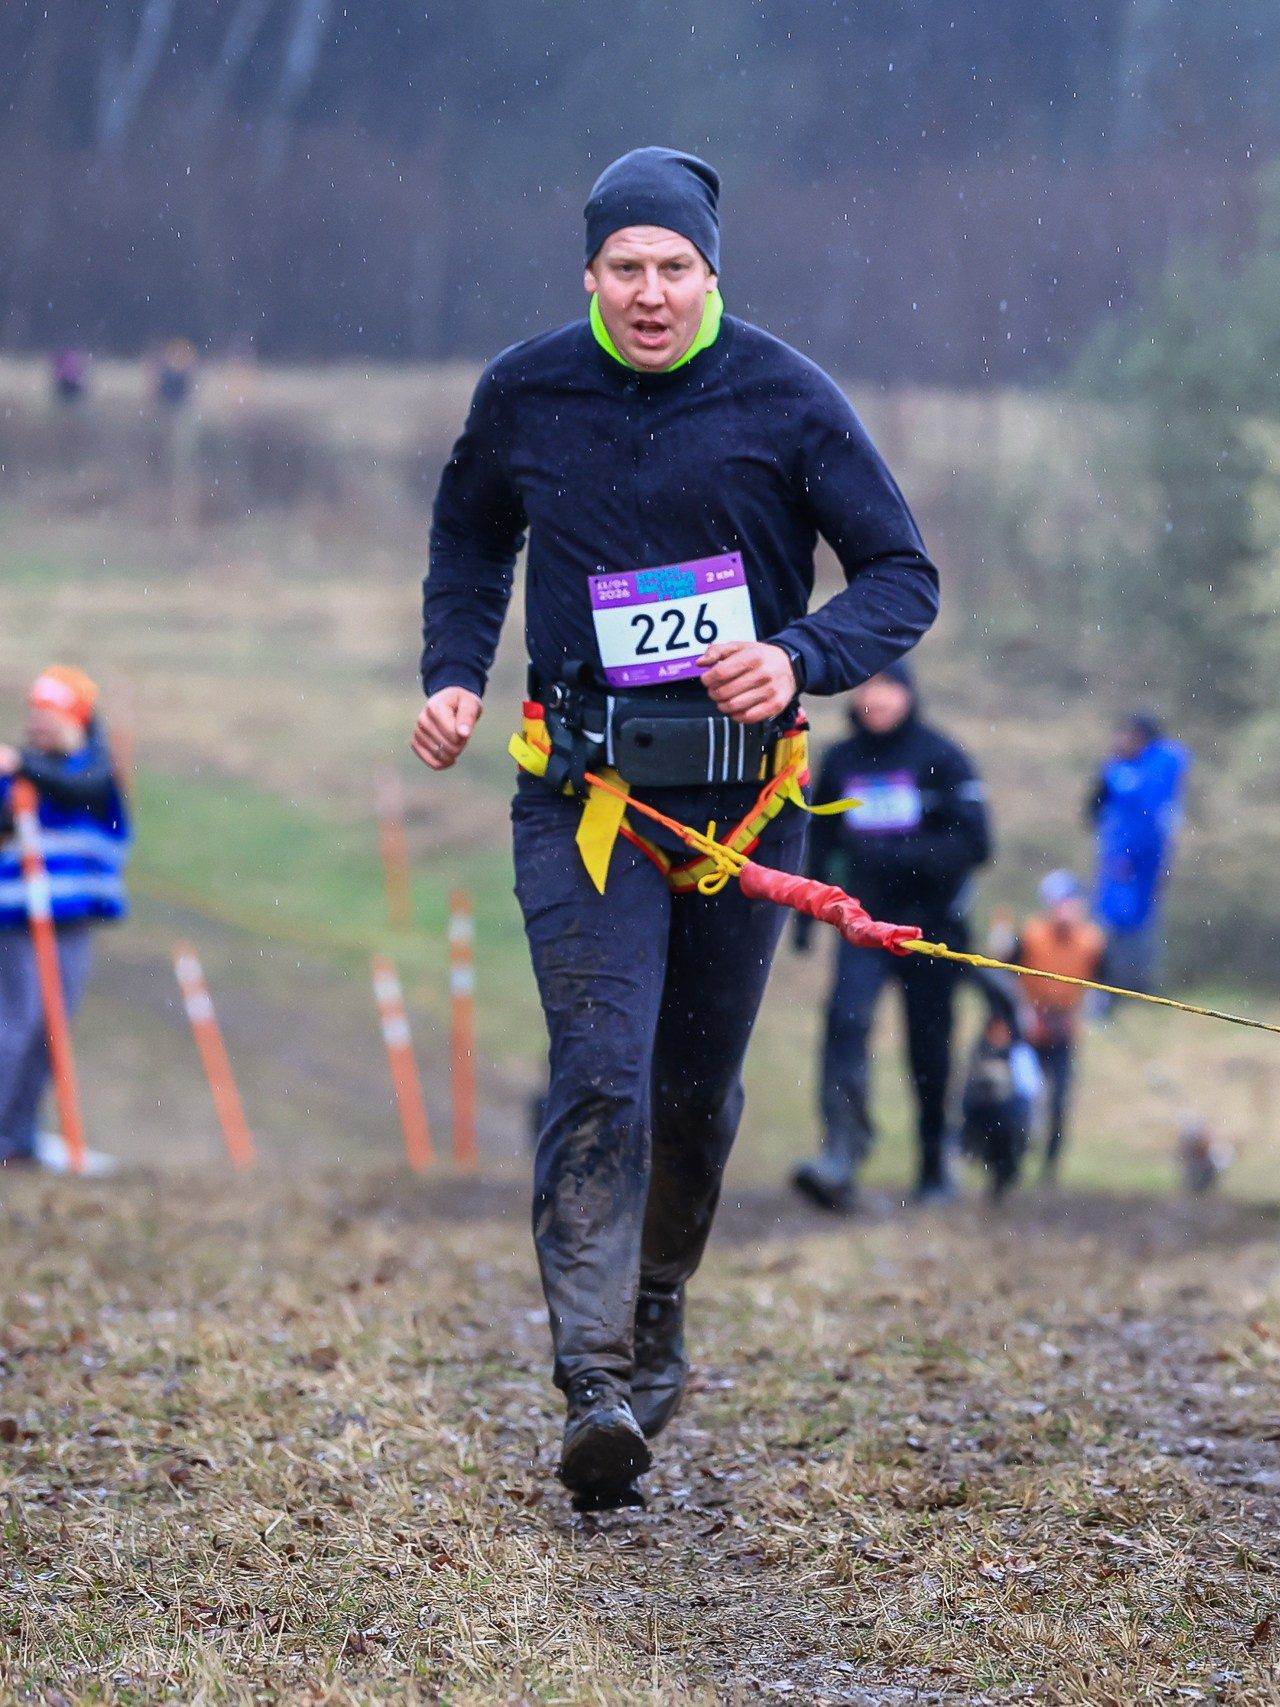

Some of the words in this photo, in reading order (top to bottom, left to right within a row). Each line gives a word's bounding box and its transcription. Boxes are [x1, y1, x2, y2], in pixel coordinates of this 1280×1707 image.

[706, 571, 715, 583] 2
[597, 578, 629, 590] 11/04
[599, 589, 631, 601] 2026
[630, 602, 718, 656] 226
